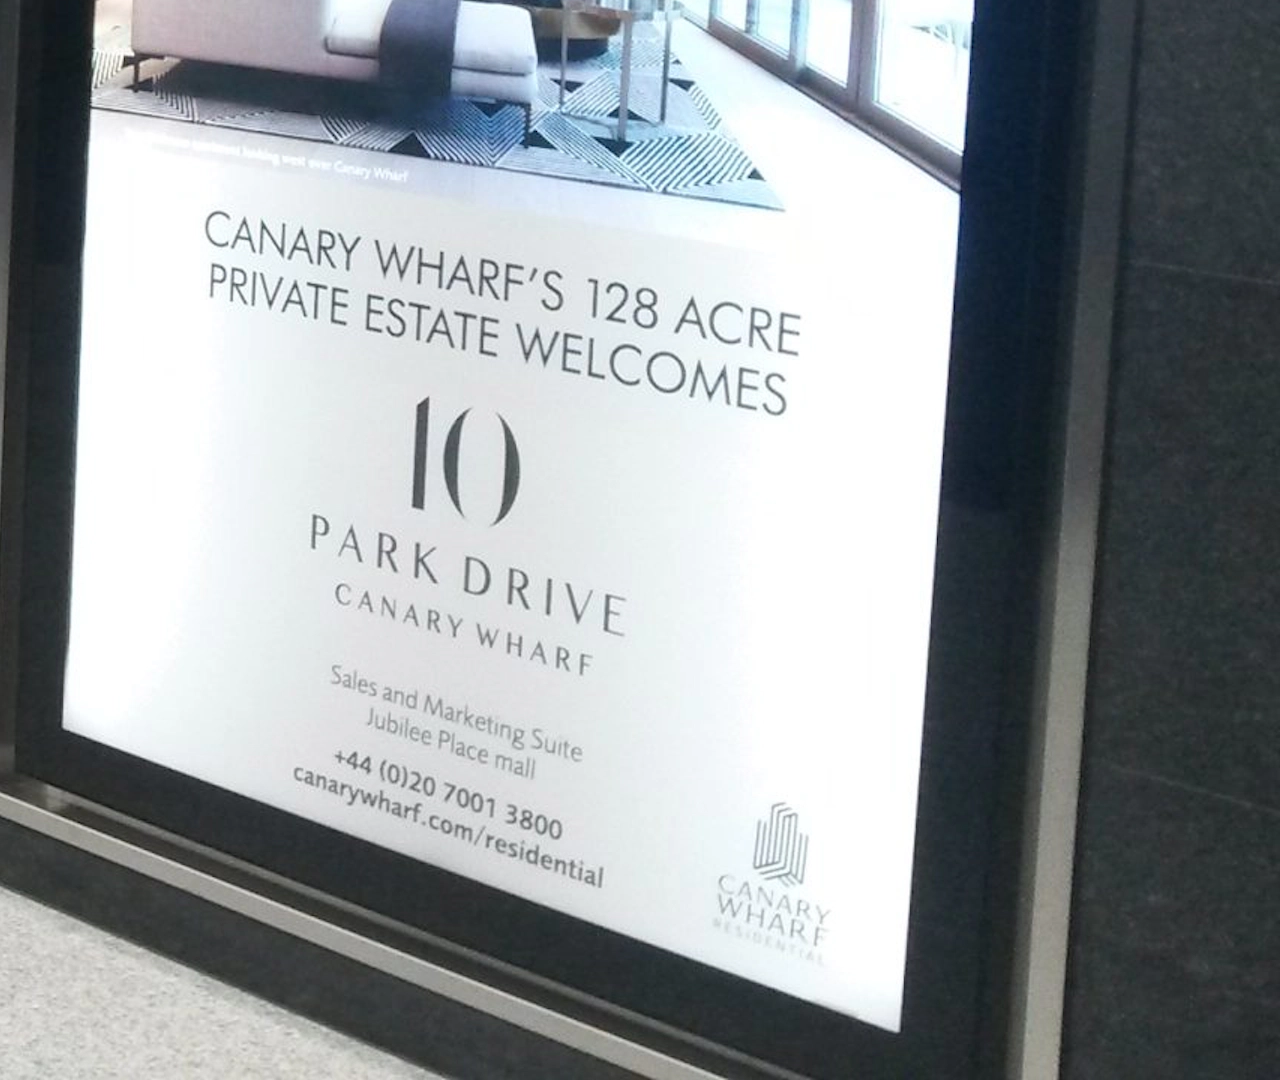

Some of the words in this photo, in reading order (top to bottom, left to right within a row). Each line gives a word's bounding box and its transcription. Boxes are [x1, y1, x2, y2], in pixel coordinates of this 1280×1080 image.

[334, 160, 372, 180] Canary
[374, 166, 410, 183] Wharf
[204, 210, 362, 272] CANARY
[373, 239, 564, 312] WHARF'S
[587, 277, 659, 330] 128
[673, 295, 802, 357] ACRE
[209, 262, 350, 327] PRIVATE
[365, 293, 500, 358] ESTATE
[515, 322, 788, 417] WELCOMES
[411, 395, 521, 527] 10
[310, 513, 439, 585] PARK
[463, 555, 627, 637] DRIVE
[334, 582, 464, 639] CANARY
[476, 622, 594, 677] WHARF
[331, 664, 378, 697] Sales
[382, 686, 418, 710] and
[423, 694, 525, 751] Marketing
[531, 728, 583, 763] Suite
[366, 707, 432, 746] Jubilee
[438, 729, 489, 764] Place
[495, 754, 536, 780] mall
[293, 767, 604, 889] canarywharf.com/residential
[334, 750, 372, 775] +44
[379, 759, 436, 797] (0)20
[443, 782, 496, 818] 7001
[505, 803, 563, 841] 3800
[717, 892, 831, 947] WHARF
[718, 874, 831, 925] CANARY
